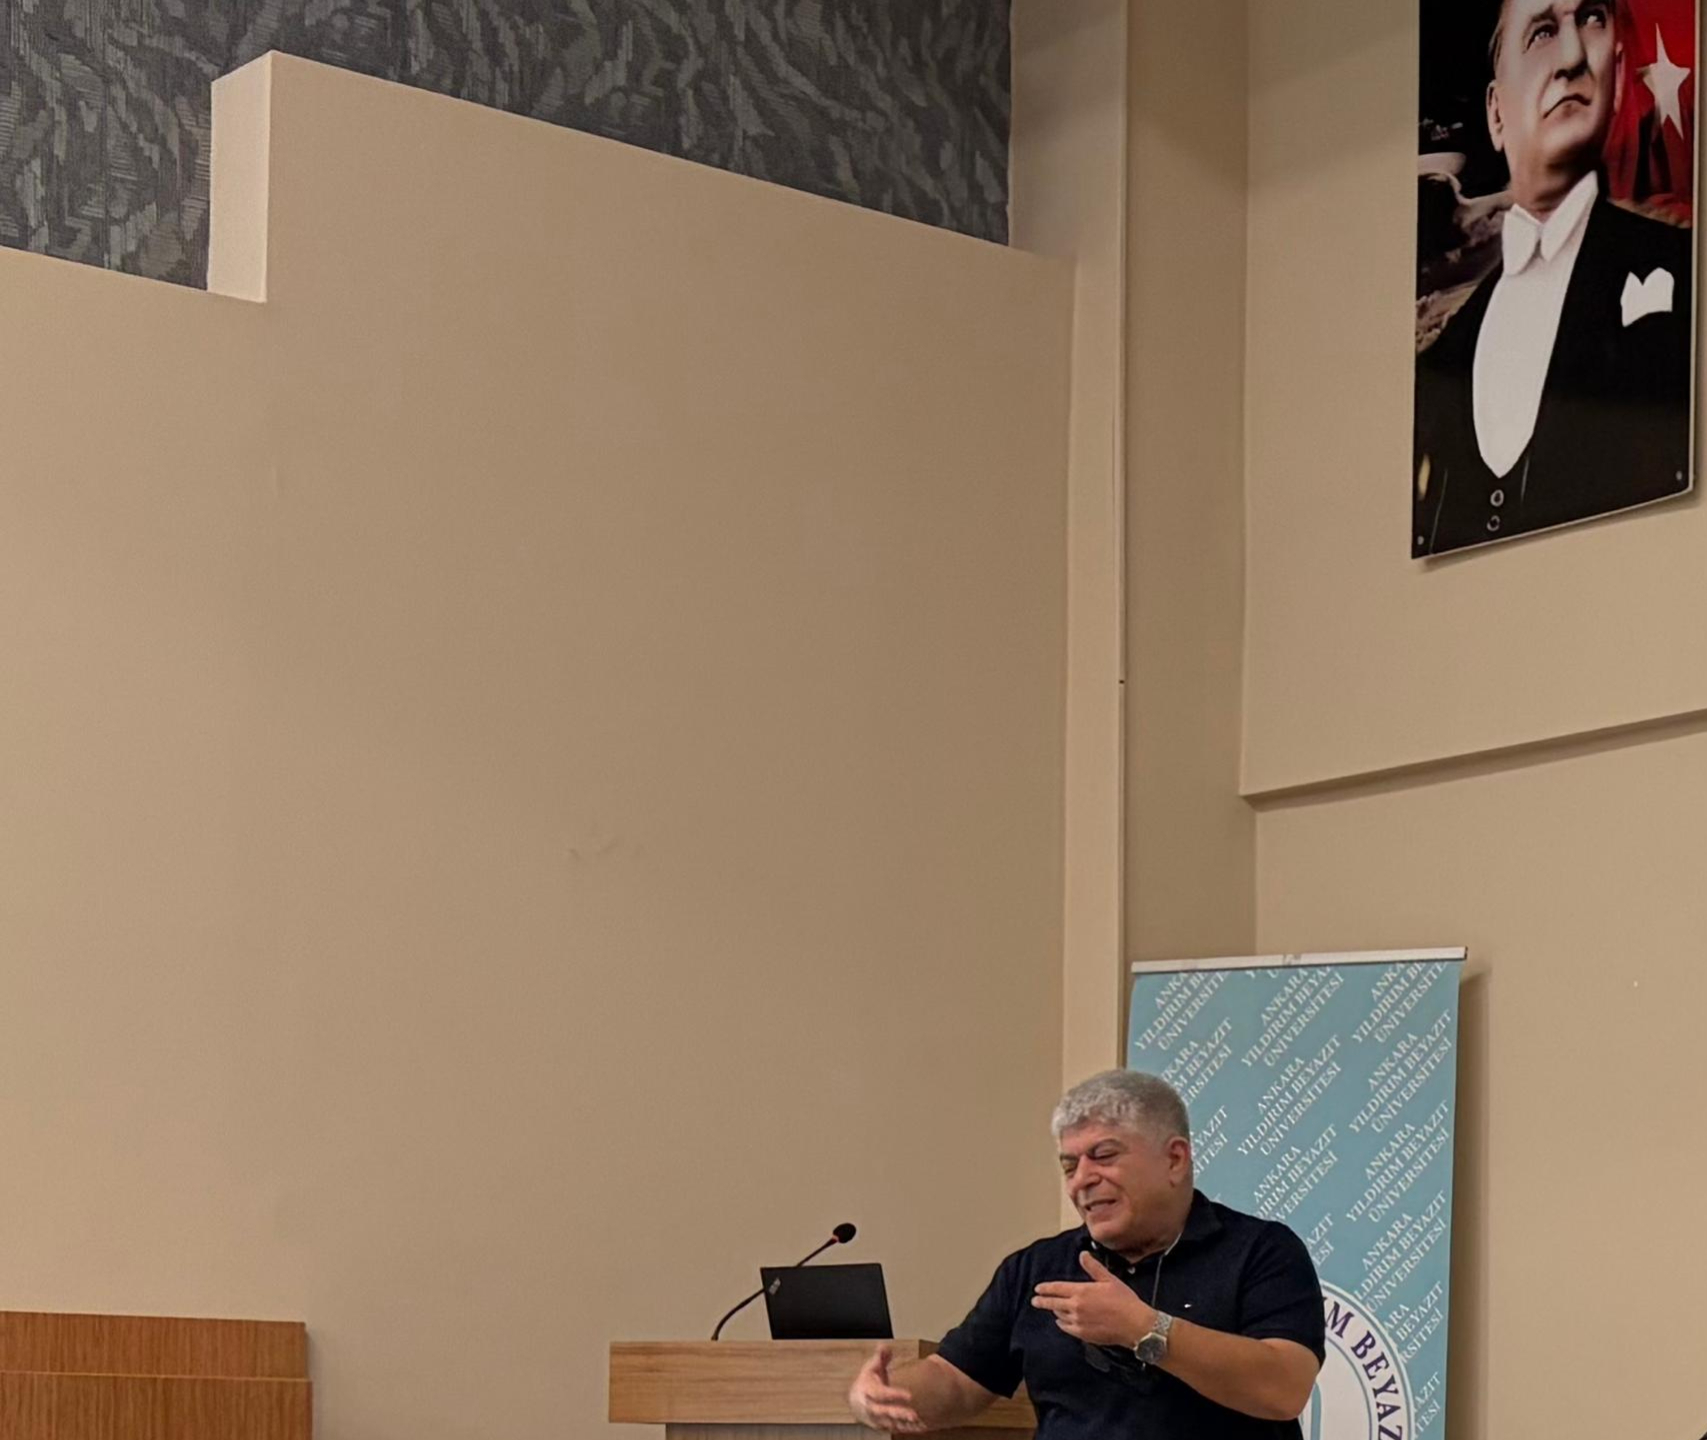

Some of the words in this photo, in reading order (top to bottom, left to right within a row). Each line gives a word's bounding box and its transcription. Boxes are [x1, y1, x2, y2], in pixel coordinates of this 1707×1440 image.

[1241, 1002, 1297, 1067] YILDIRIM
[1352, 977, 1409, 1043] YILDIRIM
[1258, 1057, 1304, 1114] ANKARA
[1349, 1068, 1407, 1133] YILDIRIM
[1404, 1009, 1451, 1070] BEYAZIT
[1368, 1032, 1418, 1091] ANKARA
[1238, 1091, 1293, 1155] YILDIRIM
[1291, 1034, 1340, 1093] BEYAZIT
[1254, 1146, 1301, 1203] ANKARA
[1288, 1123, 1337, 1182] BEYAZIT
[1346, 1157, 1404, 1222] YILDIRIM
[1402, 1100, 1449, 1160] BEYAZIT
[1365, 1123, 1415, 1180] ANKARA
[1362, 1213, 1412, 1271] ANKARA
[1399, 1190, 1446, 1250] BEYAZIT
[1396, 1281, 1443, 1341] BEYAZIT
